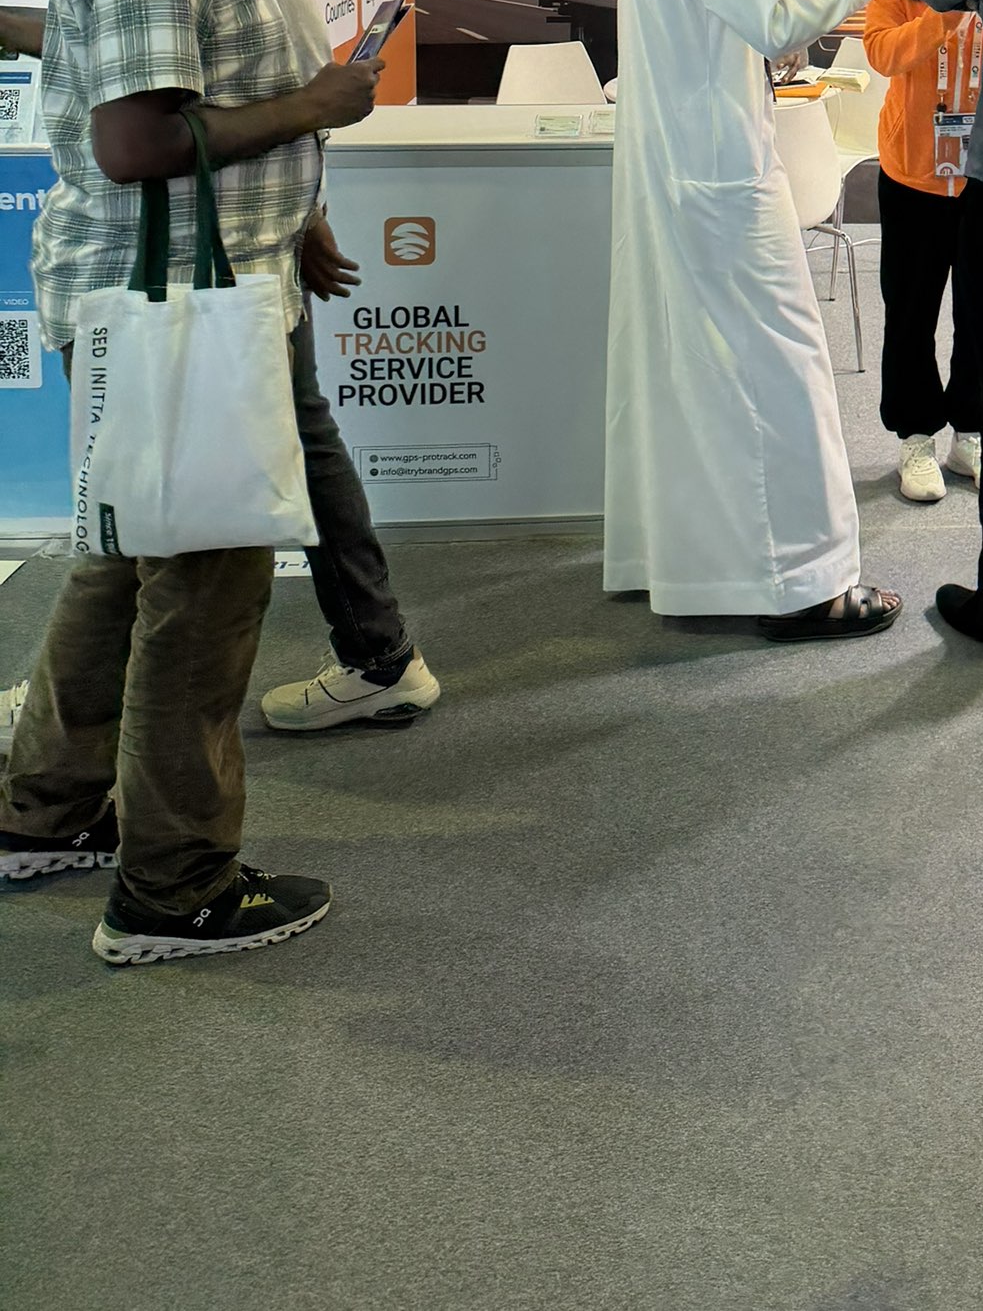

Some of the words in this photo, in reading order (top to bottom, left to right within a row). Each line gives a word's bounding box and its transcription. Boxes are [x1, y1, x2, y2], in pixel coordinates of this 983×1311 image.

[353, 305, 469, 329] GLOBAL
[92, 327, 108, 358] SED
[334, 330, 486, 355] TRACKING
[350, 356, 473, 381] SERVICE
[91, 367, 107, 424] INITTA
[338, 382, 485, 406] PROVIDER
[380, 452, 477, 464] www.gps-protrack.com
[380, 466, 478, 477] info@itrybrandgps.com
[75, 434, 97, 553] TECHNOLOG
